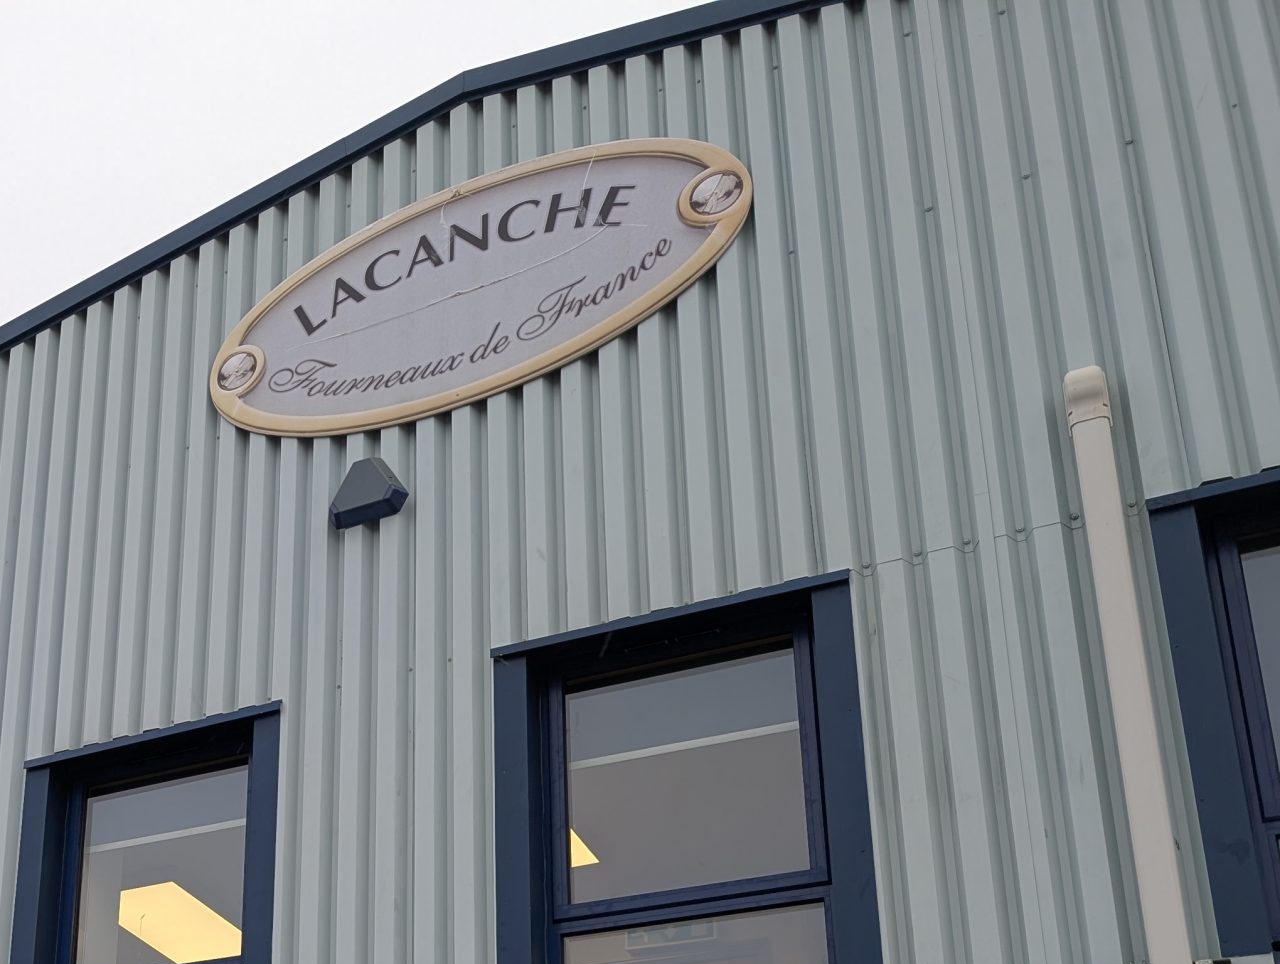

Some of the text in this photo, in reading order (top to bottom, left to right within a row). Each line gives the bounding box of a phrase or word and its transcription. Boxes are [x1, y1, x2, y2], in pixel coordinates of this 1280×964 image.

[268, 235, 672, 398] Fourneaux de France
[293, 185, 636, 337] LACANCHE
